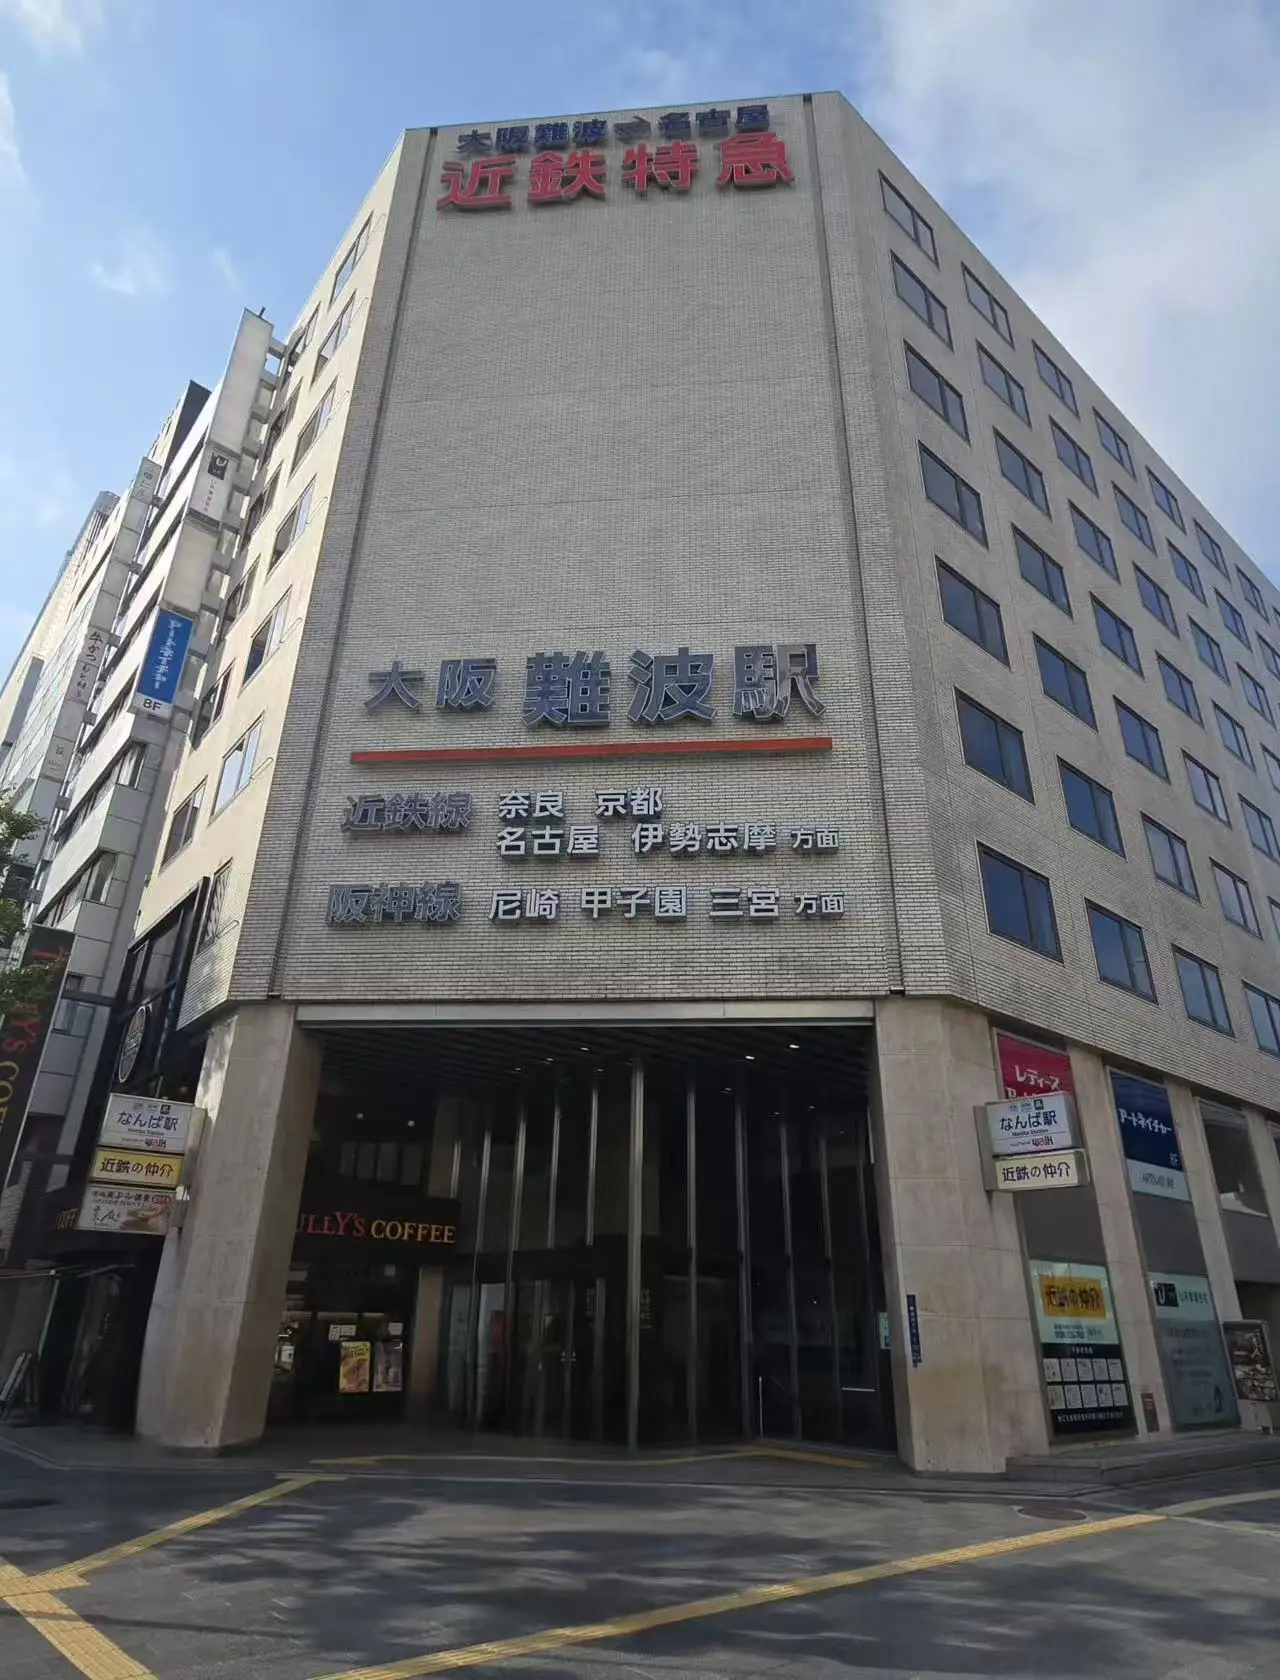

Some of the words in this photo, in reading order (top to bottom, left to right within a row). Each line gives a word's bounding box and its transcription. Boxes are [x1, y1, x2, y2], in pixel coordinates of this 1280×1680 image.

[457, 118, 607, 154] 大阪難波
[658, 104, 771, 136] 名古屋
[437, 132, 795, 210] 近鉄特急
[364, 644, 827, 727] 大阪難波駅
[143, 698, 162, 711] 8F
[341, 791, 474, 833] 近鉄線
[498, 788, 564, 819] 奈良
[594, 786, 663, 817] 京都
[496, 825, 599, 857] 名古屋
[631, 820, 777, 852] 伊勢志摩
[790, 829, 840, 851] 方面
[327, 882, 462, 925] 阪神線
[489, 889, 560, 921] 尼崎
[580, 886, 688, 920] 甲子園
[708, 885, 780, 920] 三宮
[795, 893, 844, 916] 方面
[1014, 1065, 1063, 1089] レディース
[117, 1111, 178, 1131] なんば駅
[999, 1110, 1057, 1131] なんば駅
[1118, 1108, 1172, 1135] アートネイチャー
[99, 1157, 174, 1178] 近鉄の仲介
[1002, 1162, 1071, 1183] 近鉄の仲介
[371, 1220, 457, 1244] COFFEE
